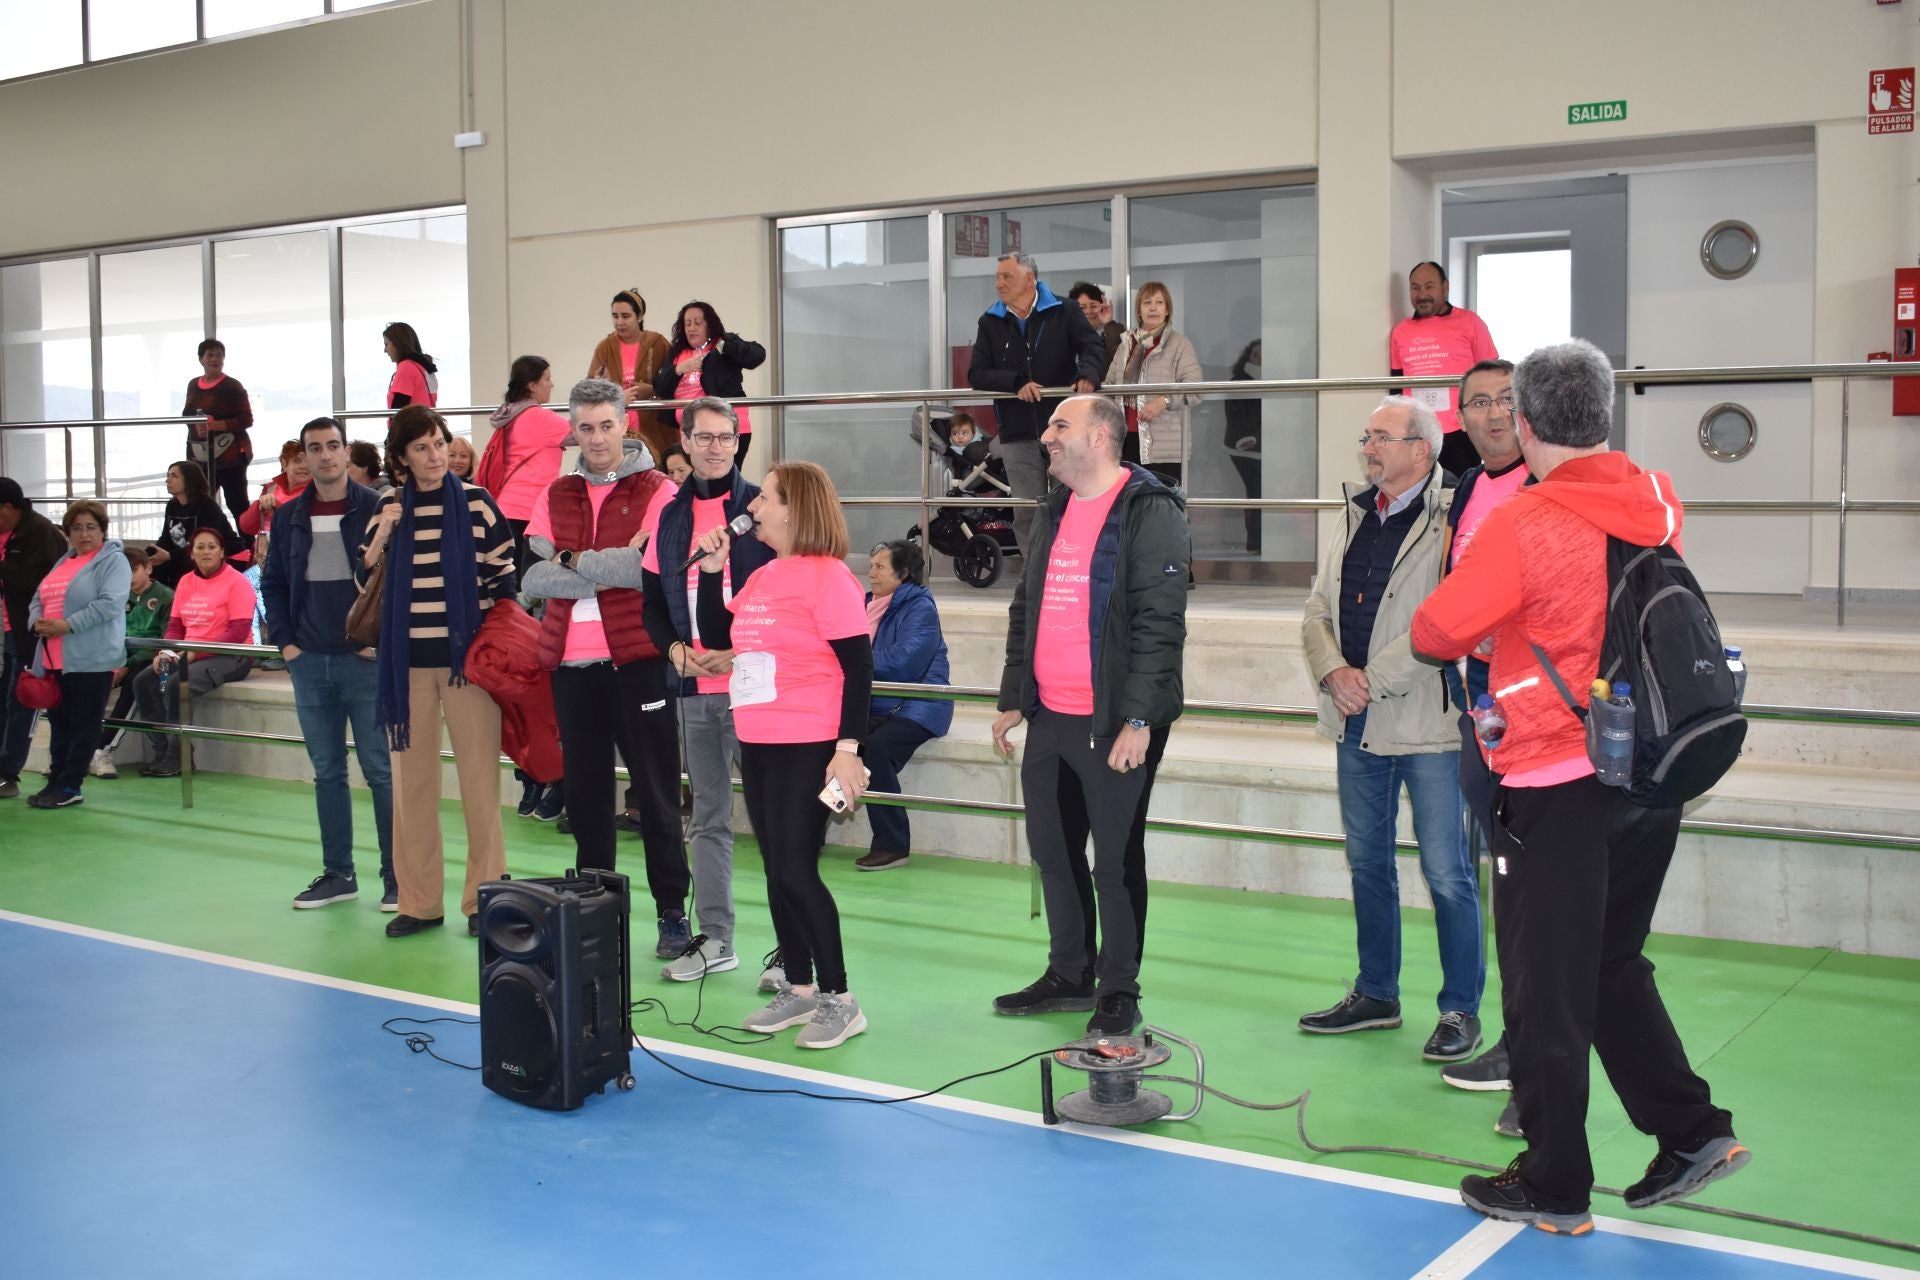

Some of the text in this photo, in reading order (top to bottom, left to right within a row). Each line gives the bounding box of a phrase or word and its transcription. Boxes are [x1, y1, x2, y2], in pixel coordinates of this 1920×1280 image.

[1571, 103, 1623, 122] SALIDA
[1870, 115, 1912, 125] PULSADOR
[1870, 123, 1911, 133] DE ALARMA
[1055, 573, 1065, 582] el
